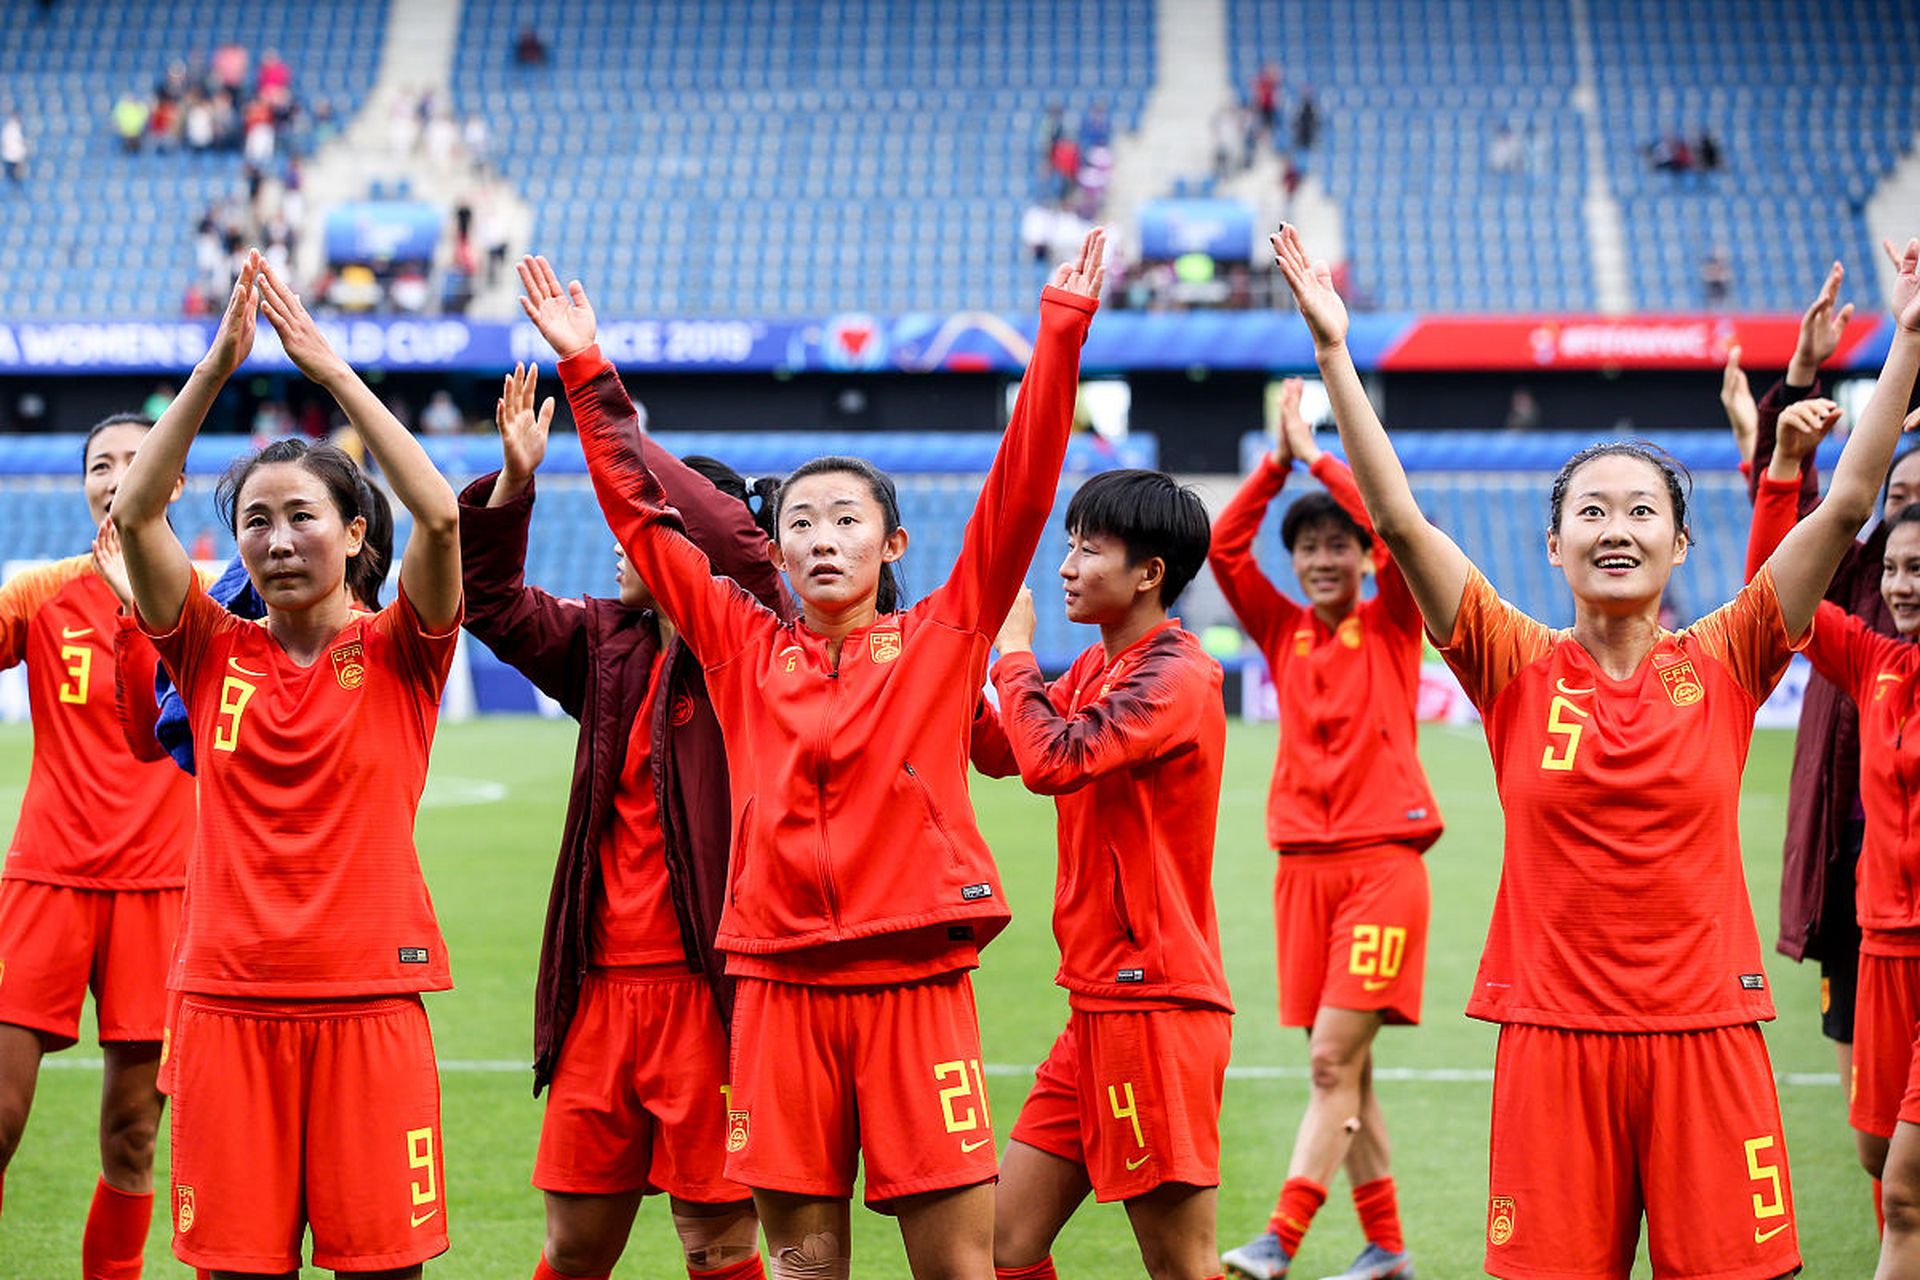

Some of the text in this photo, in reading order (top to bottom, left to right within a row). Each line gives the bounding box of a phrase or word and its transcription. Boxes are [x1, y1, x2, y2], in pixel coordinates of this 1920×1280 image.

[60, 645, 92, 705] 3
[334, 645, 362, 662] CFA
[1663, 665, 1692, 683] CFA
[213, 676, 257, 752] 9
[1541, 696, 1588, 771] 5
[1349, 924, 1407, 977] 20
[934, 1060, 990, 1133] 21
[1107, 1082, 1145, 1148] 4
[406, 1127, 437, 1206] 9
[1744, 1135, 1785, 1219] 5
